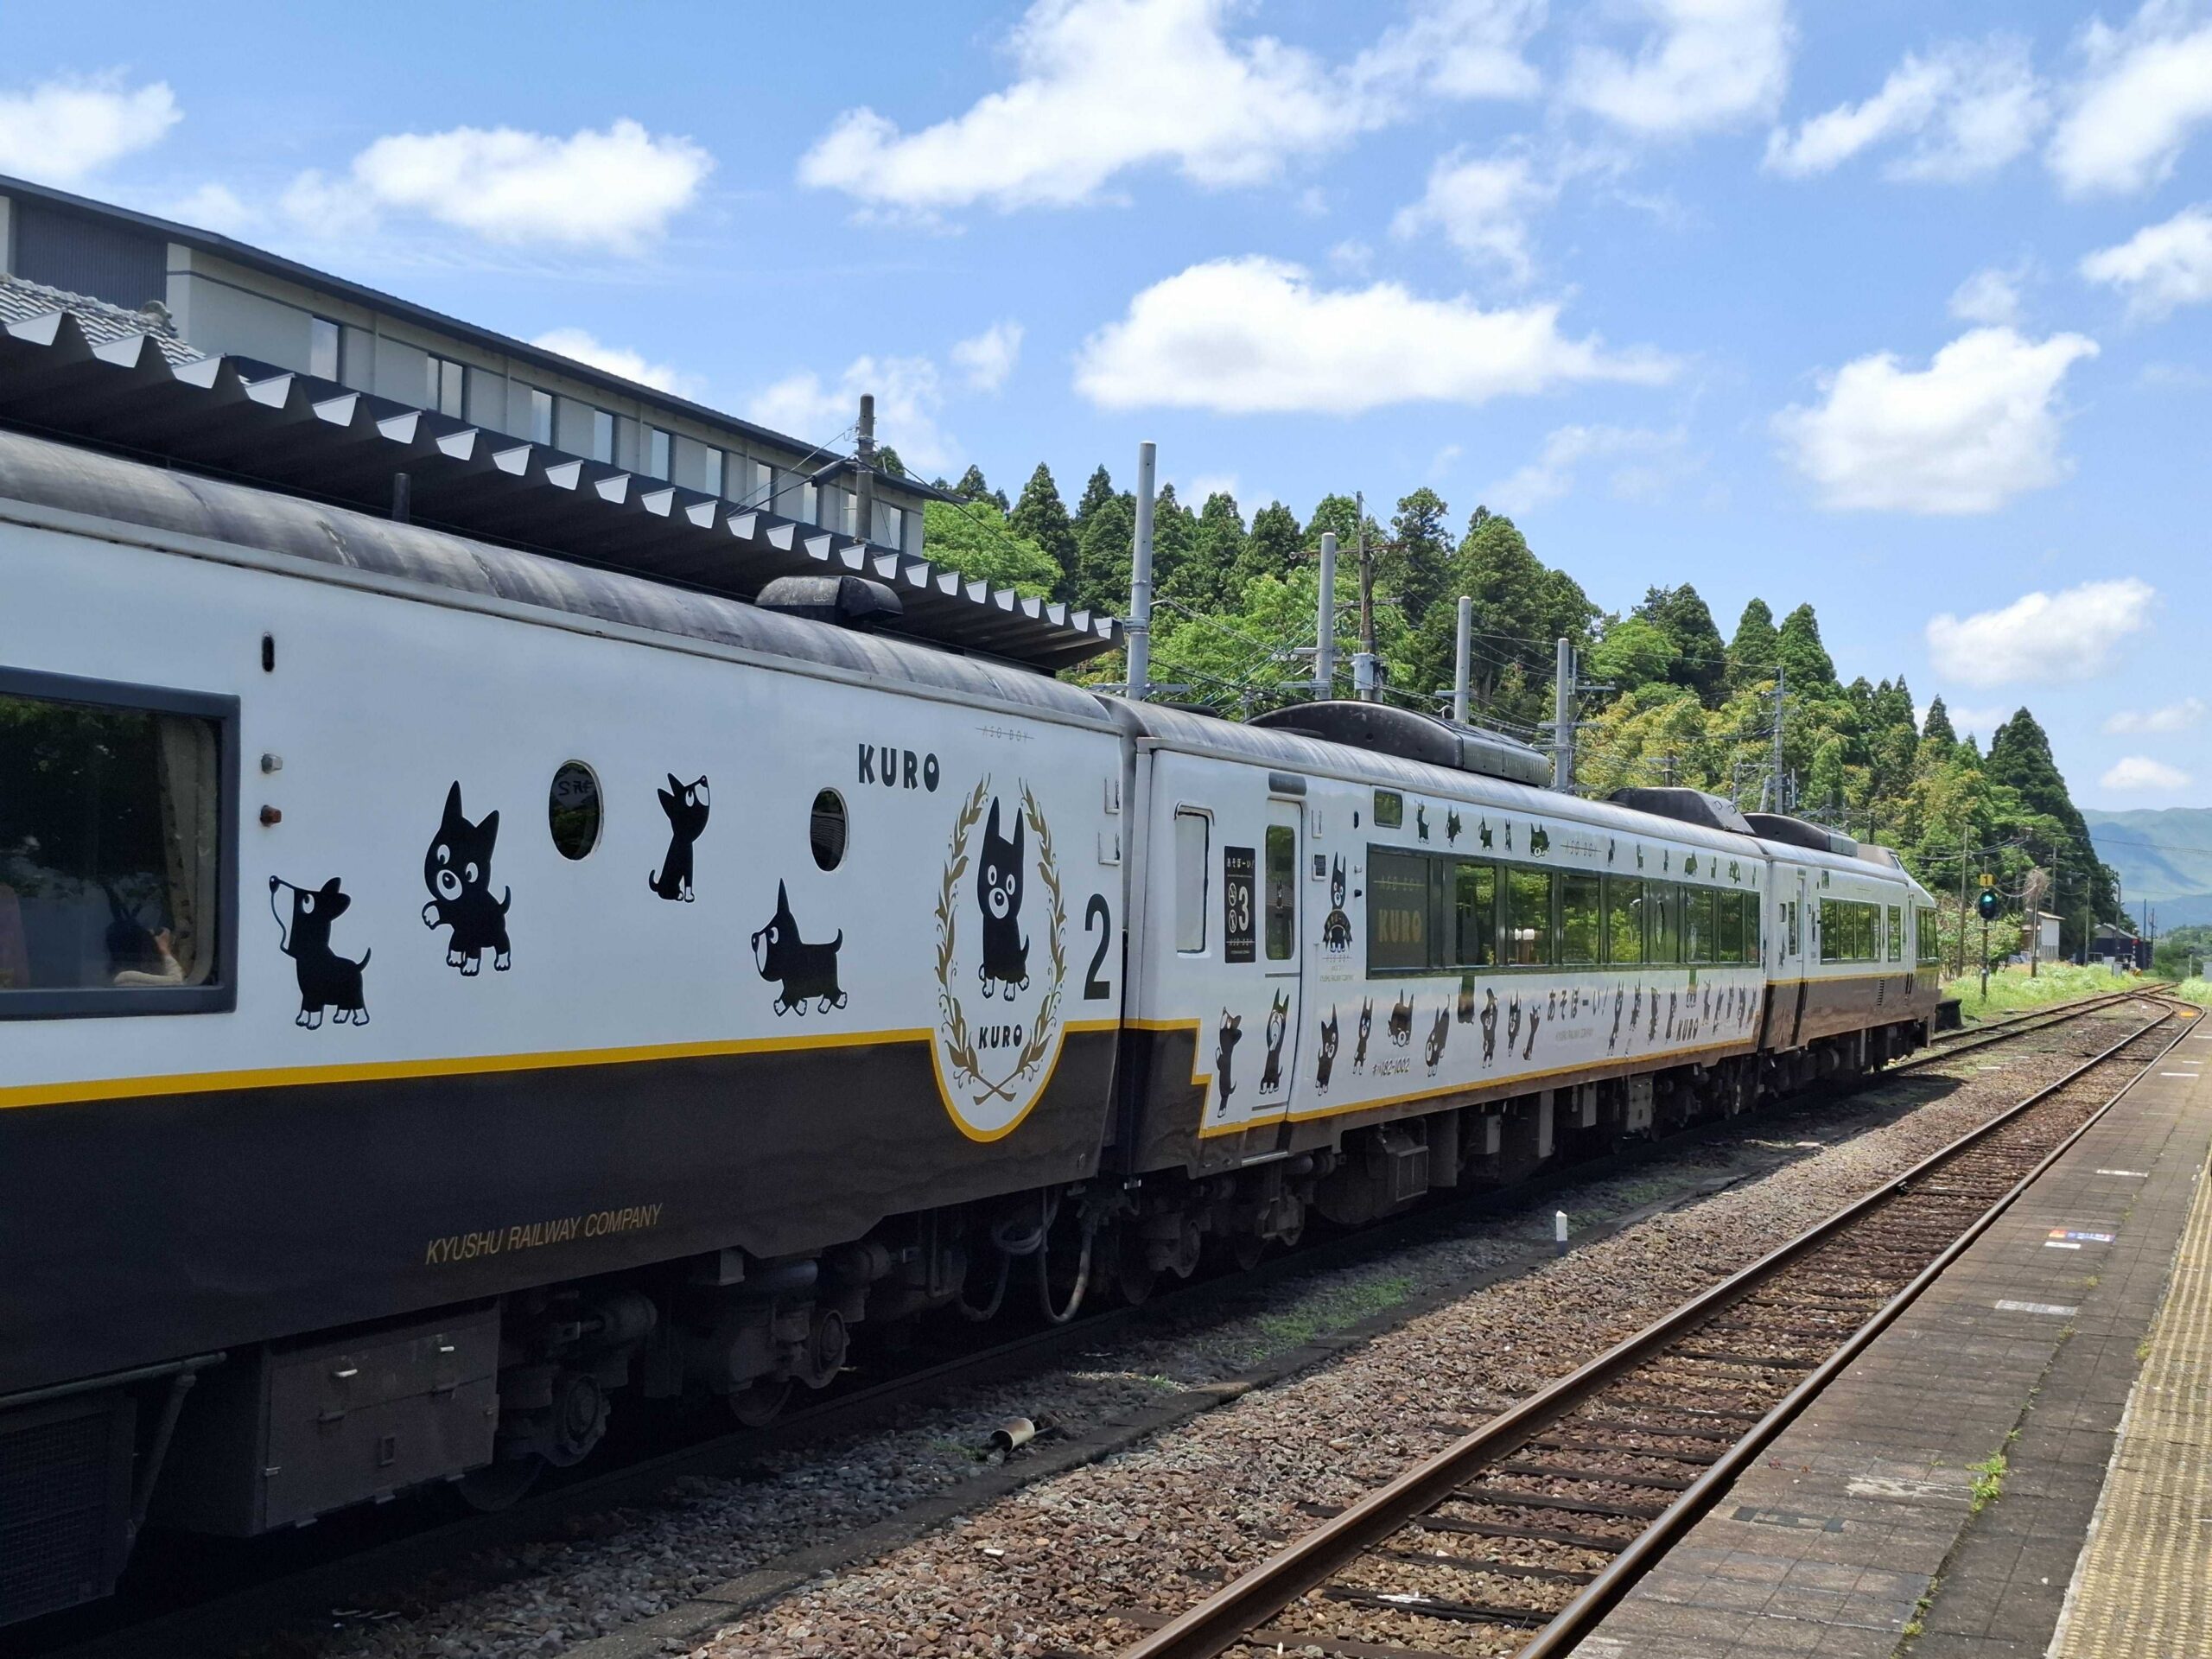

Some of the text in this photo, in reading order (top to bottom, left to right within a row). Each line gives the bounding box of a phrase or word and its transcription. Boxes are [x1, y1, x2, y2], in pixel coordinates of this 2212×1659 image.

[858, 743, 940, 792] KURO
[1238, 886, 1249, 931] 3
[1378, 909, 1422, 944] KURO
[1084, 893, 1110, 1000] 2
[978, 1024, 1022, 1049] KURO
[425, 1203, 663, 1265] KYUSHU RAILWAY COMPANY
